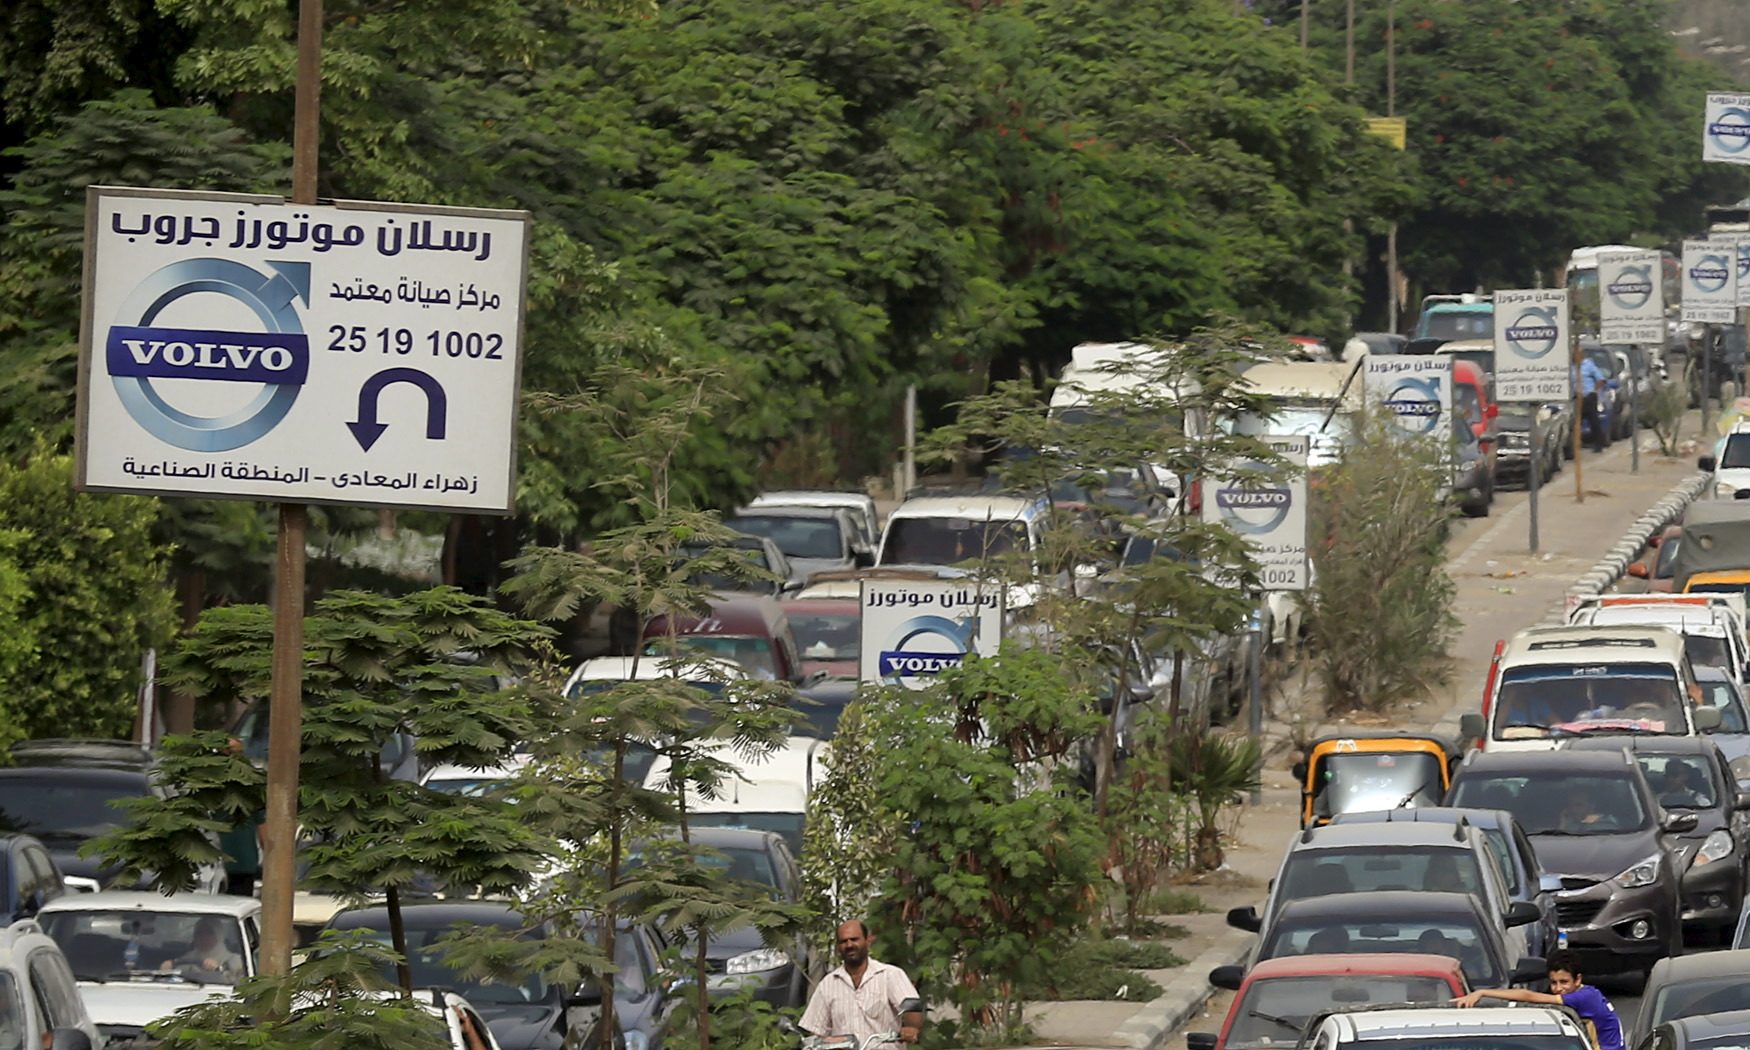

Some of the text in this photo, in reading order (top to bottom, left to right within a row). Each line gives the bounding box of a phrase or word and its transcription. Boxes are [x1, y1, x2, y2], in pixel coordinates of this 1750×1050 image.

[111, 210, 491, 260] رسلان موتورز جروب
[329, 277, 501, 311] مركز صيانة معتمد
[328, 325, 503, 360] 25 19 1002
[1509, 330, 1555, 338] VOLVO
[122, 340, 294, 372] VOLVO
[122, 457, 216, 481] الصناعية
[221, 461, 309, 484] المنطقة
[423, 475, 478, 494] زهراء
[1222, 493, 1287, 504] VOLVO
[867, 588, 933, 608] موتورز
[887, 657, 963, 672] VOLV
